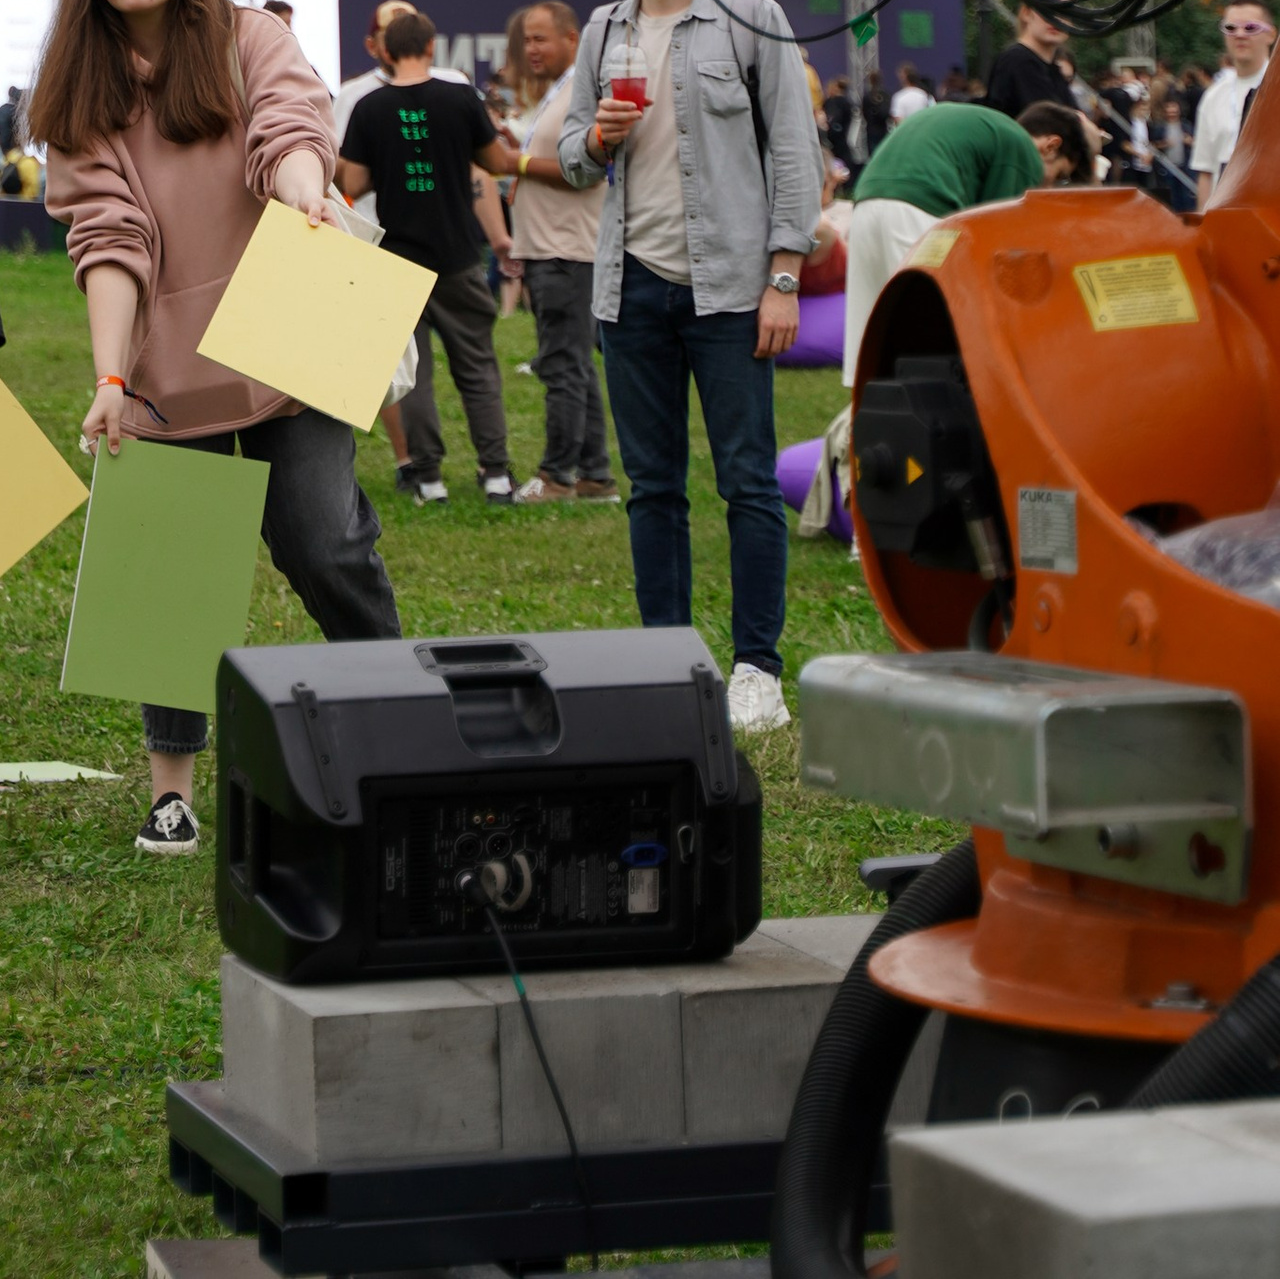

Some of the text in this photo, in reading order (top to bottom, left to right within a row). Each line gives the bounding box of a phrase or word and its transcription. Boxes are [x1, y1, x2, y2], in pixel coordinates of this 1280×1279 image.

[398, 108, 427, 122] tac
[401, 125, 429, 140] tic
[405, 161, 433, 174] stu
[405, 176, 435, 192] dio
[1020, 490, 1051, 502] KUKA
[386, 846, 395, 891] QSC
